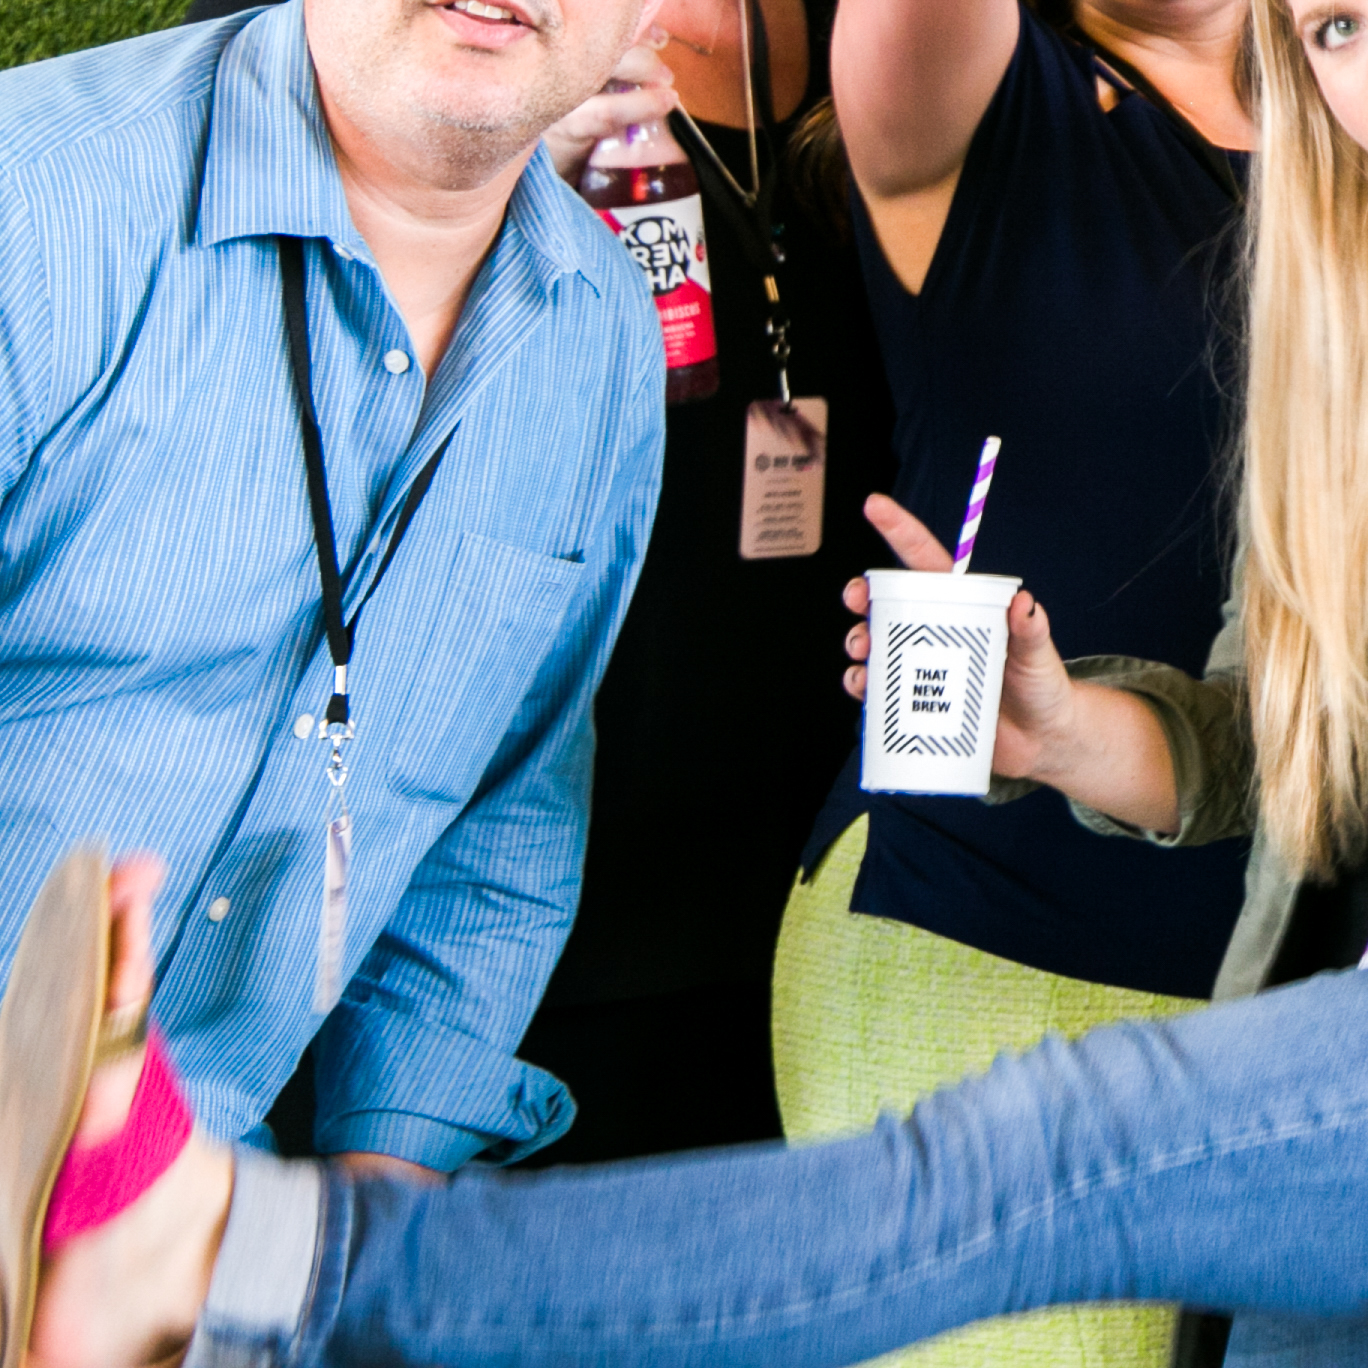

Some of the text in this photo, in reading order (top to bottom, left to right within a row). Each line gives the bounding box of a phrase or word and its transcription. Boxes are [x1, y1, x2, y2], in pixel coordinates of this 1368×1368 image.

[619, 217, 685, 249] KOM
[630, 239, 690, 269] REW
[647, 263, 687, 292] HA
[915, 668, 948, 682] THAT
[913, 684, 945, 697] NEW
[911, 700, 951, 713] BREW
